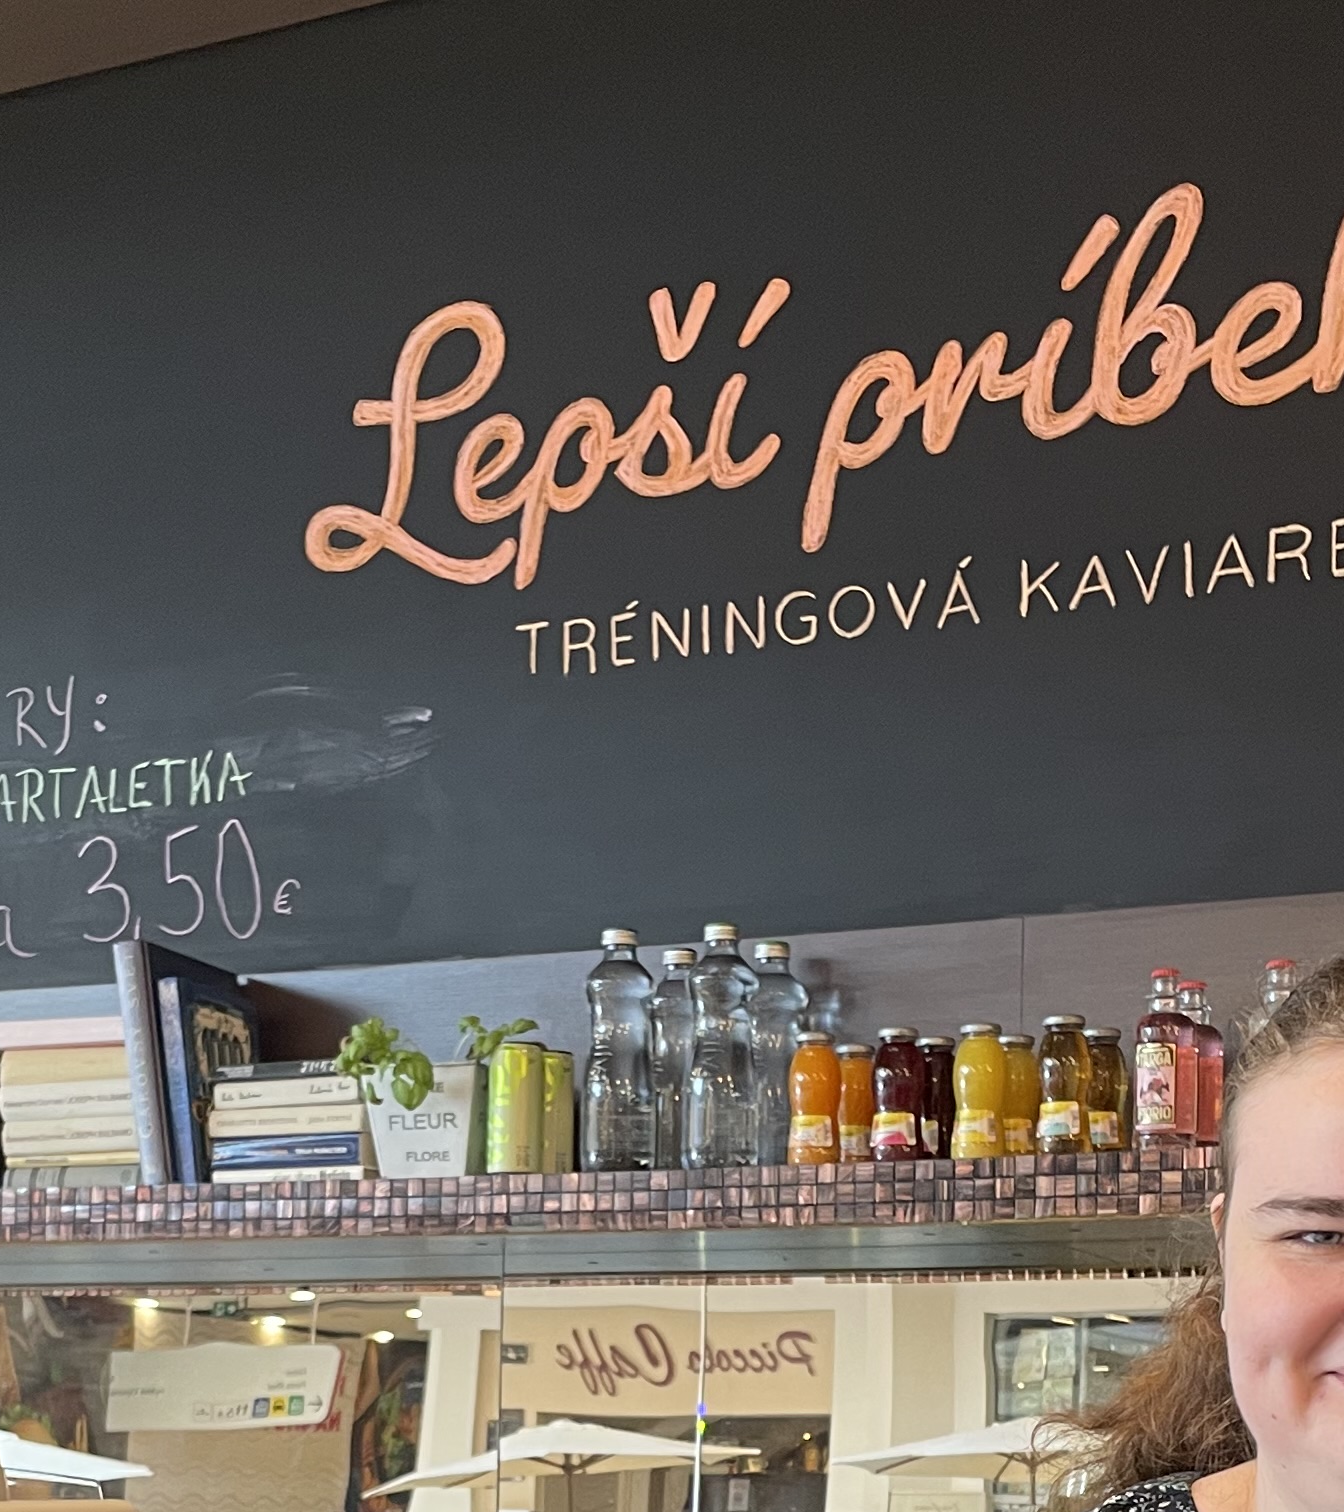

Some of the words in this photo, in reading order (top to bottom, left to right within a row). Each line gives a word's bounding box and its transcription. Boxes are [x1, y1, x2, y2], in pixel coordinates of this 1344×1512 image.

[303, 277, 792, 590] Lepší
[515, 553, 983, 678] TRÉNINGOVÁ
[388, 1111, 458, 1131] FLEUR
[405, 1150, 451, 1163] FLORE
